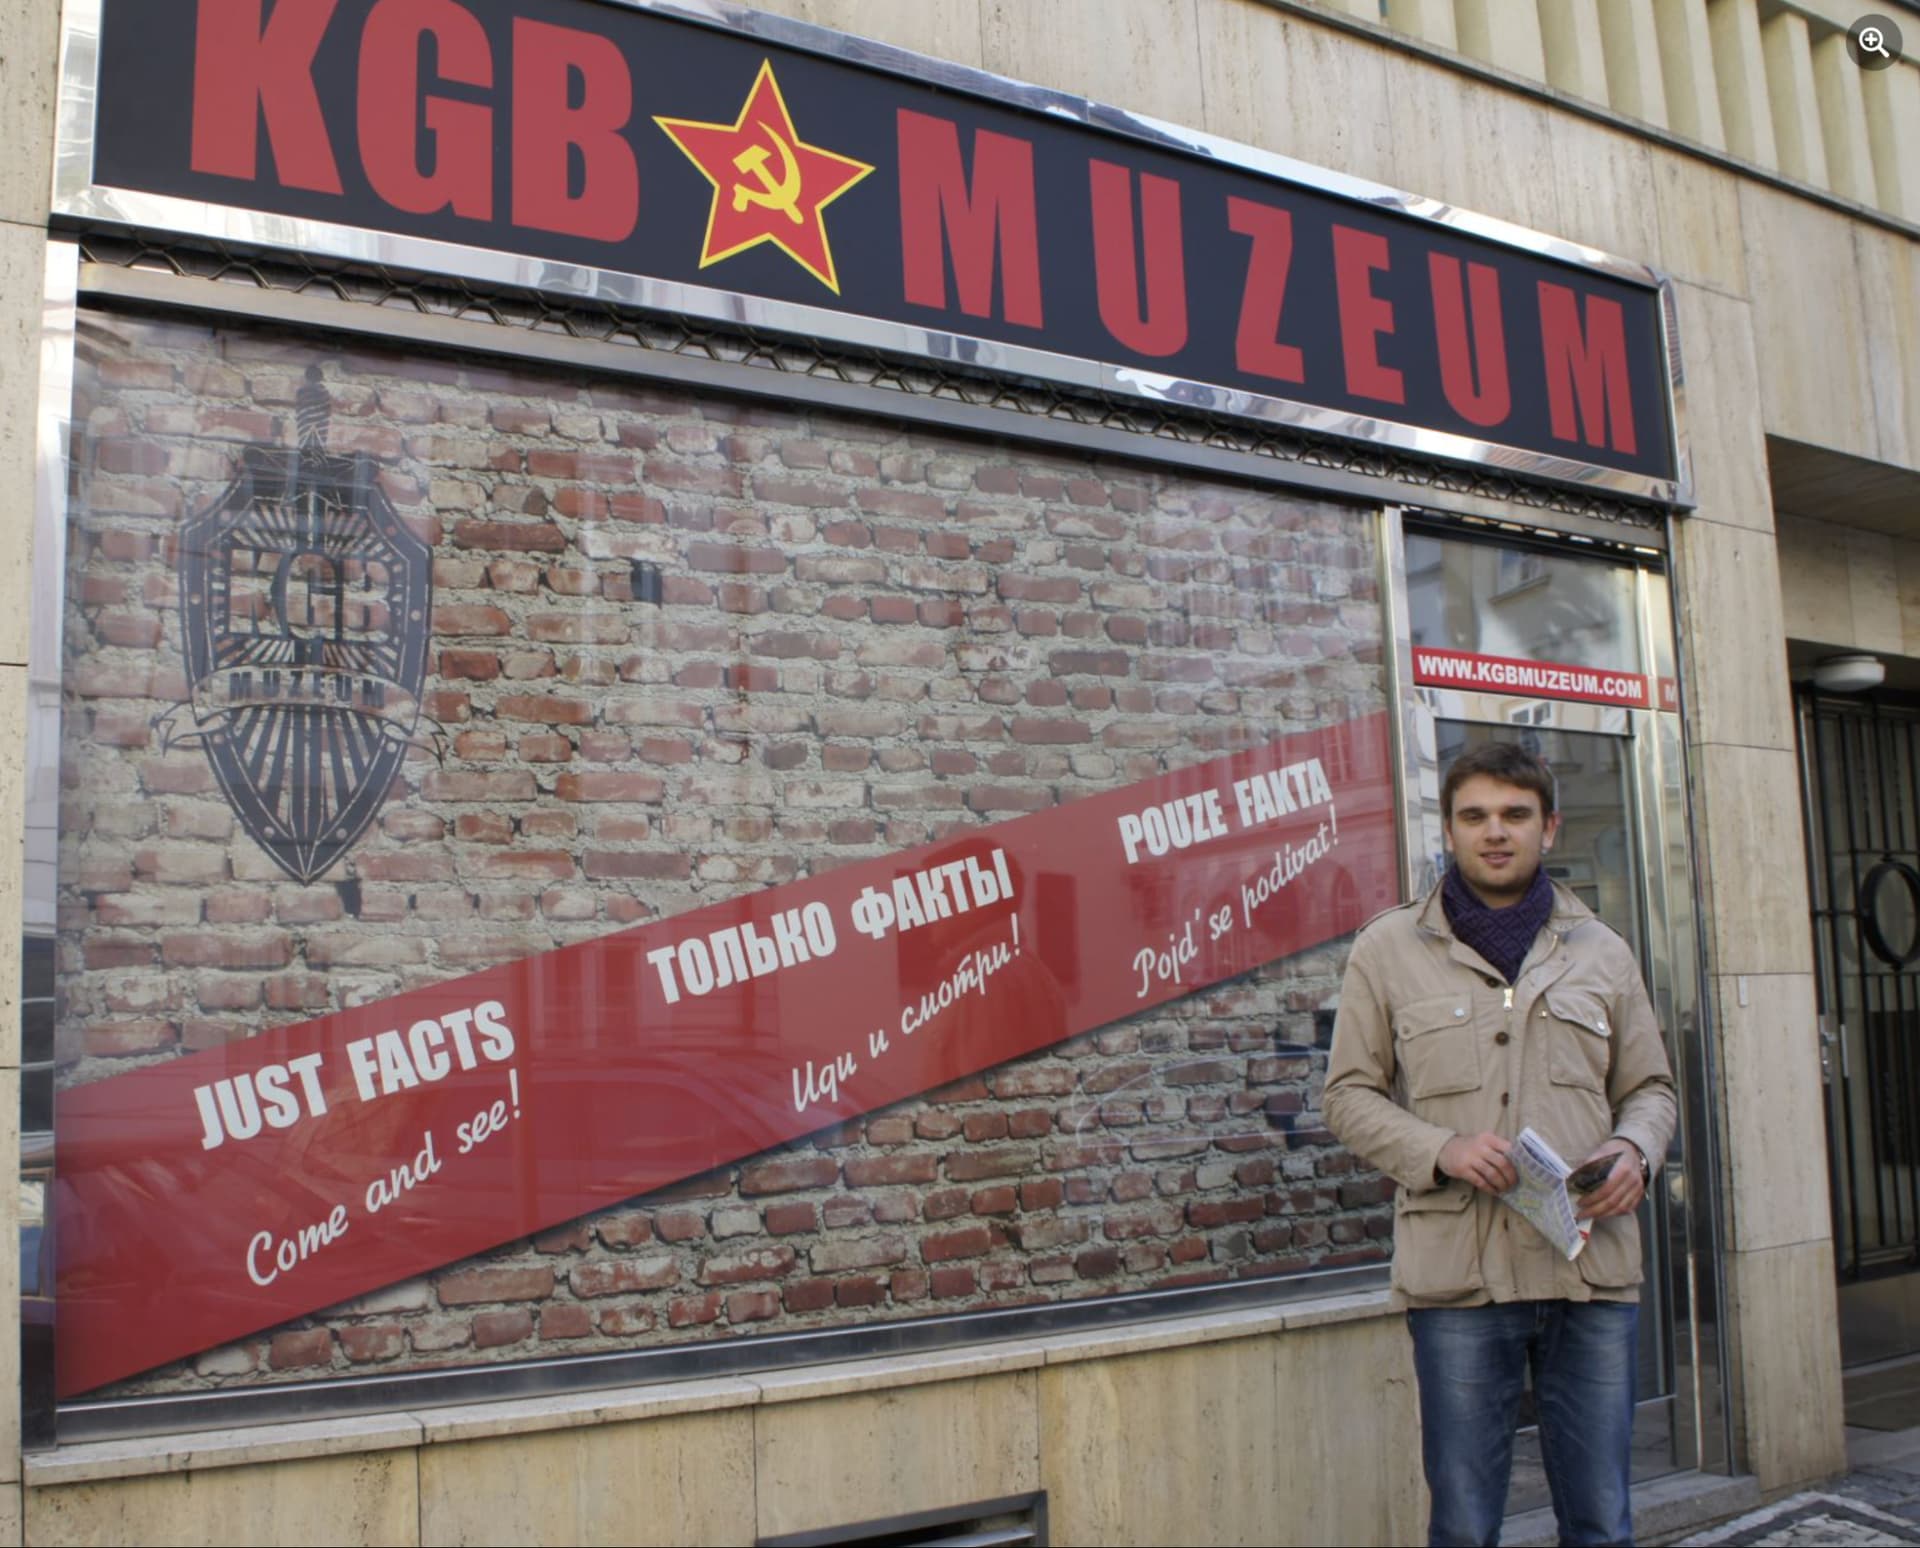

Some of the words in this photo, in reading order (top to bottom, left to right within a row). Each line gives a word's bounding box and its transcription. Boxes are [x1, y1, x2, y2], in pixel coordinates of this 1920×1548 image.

[191, 0, 640, 244] KGB
[896, 107, 1637, 456] MUZEUM
[228, 548, 392, 641] KGB
[229, 670, 385, 709] MUZEUM
[1418, 654, 1642, 698] WWW.KGBMUZEUM.COM
[1117, 788, 1229, 865] POUZE
[1233, 757, 1333, 828] FAKTA
[647, 901, 837, 1004] ТОЛЬКО
[851, 848, 1014, 940] ФАКТЫ
[1208, 904, 1233, 941] se
[193, 1053, 328, 1151] JUST
[346, 1000, 515, 1102] FACTS
[246, 1205, 349, 1286] Come
[365, 1131, 442, 1213] and
[457, 1069, 521, 1154] see!
